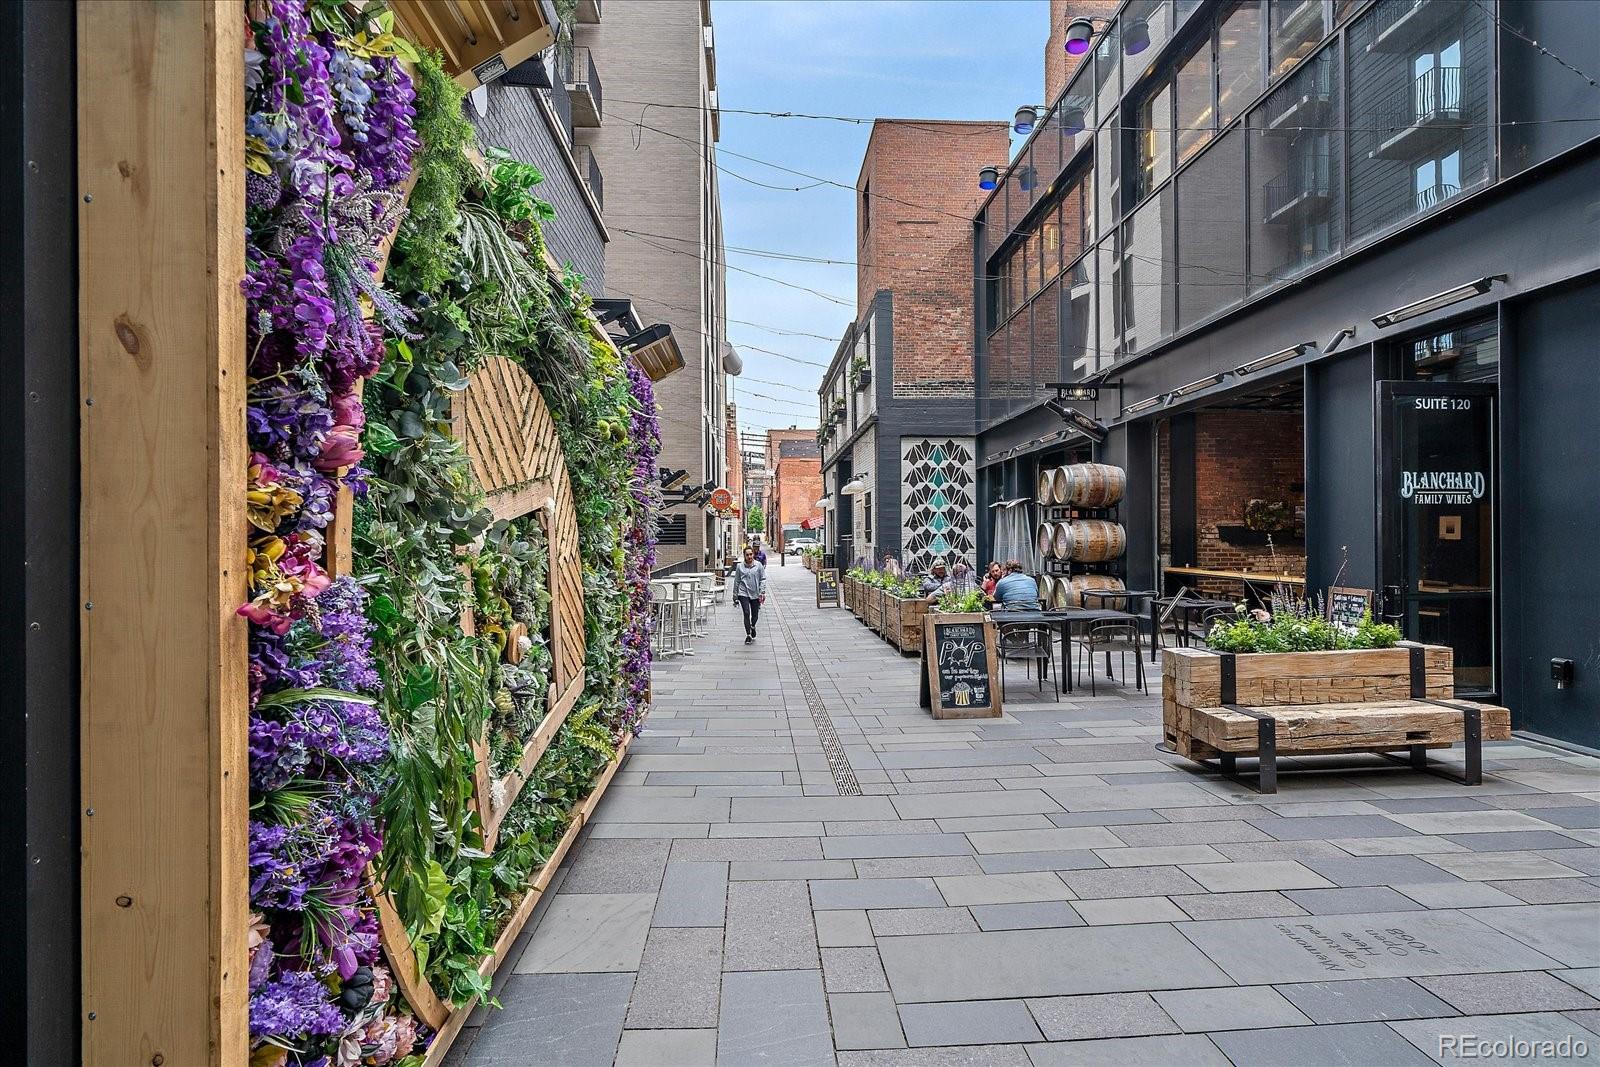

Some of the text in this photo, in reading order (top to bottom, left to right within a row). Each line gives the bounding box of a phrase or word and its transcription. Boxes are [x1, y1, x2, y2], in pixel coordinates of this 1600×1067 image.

[1061, 388, 1096, 399] BLANHARD
[1415, 398, 1471, 410] SUITE 120
[1401, 471, 1485, 498] BLANCHARD
[1415, 494, 1473, 505] FAMILY WINES
[1274, 924, 1346, 971] Memories
[1295, 924, 1366, 968] Captured
[1340, 932, 1382, 956] Here
[1365, 929, 1408, 956] Open
[1385, 928, 1440, 955] 2068
